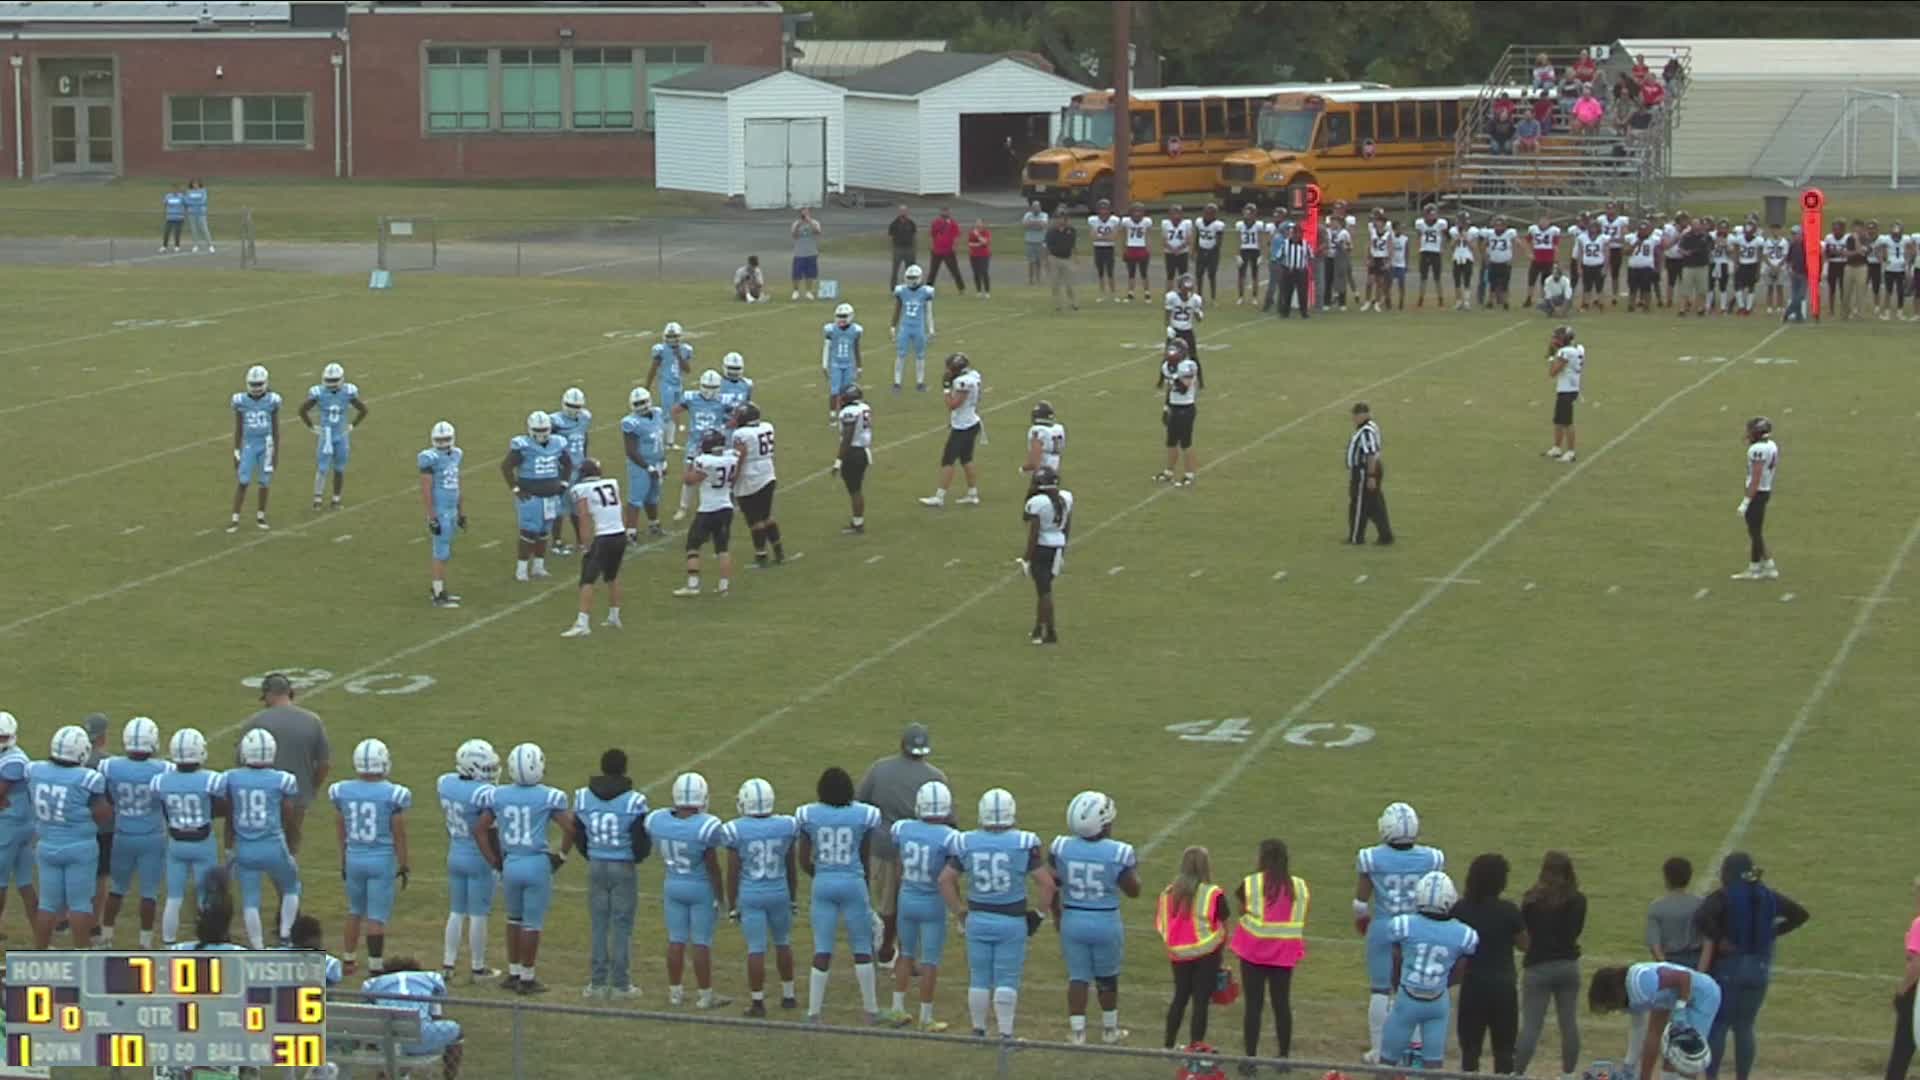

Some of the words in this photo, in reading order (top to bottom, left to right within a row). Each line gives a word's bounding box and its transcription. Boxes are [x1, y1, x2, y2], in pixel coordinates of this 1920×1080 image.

[59, 75, 71, 93] C
[1173, 306, 1191, 321] 25
[594, 483, 619, 507] 13
[1165, 717, 1376, 747] 40
[34, 783, 67, 823] 67
[237, 788, 268, 828] 18
[347, 801, 377, 842] 13
[503, 804, 533, 846] 31
[747, 838, 782, 880] 35
[815, 827, 852, 865] 88
[903, 846, 931, 885] 21
[971, 851, 1012, 894] 56
[1066, 860, 1106, 900] 55
[1407, 942, 1449, 987] 16
